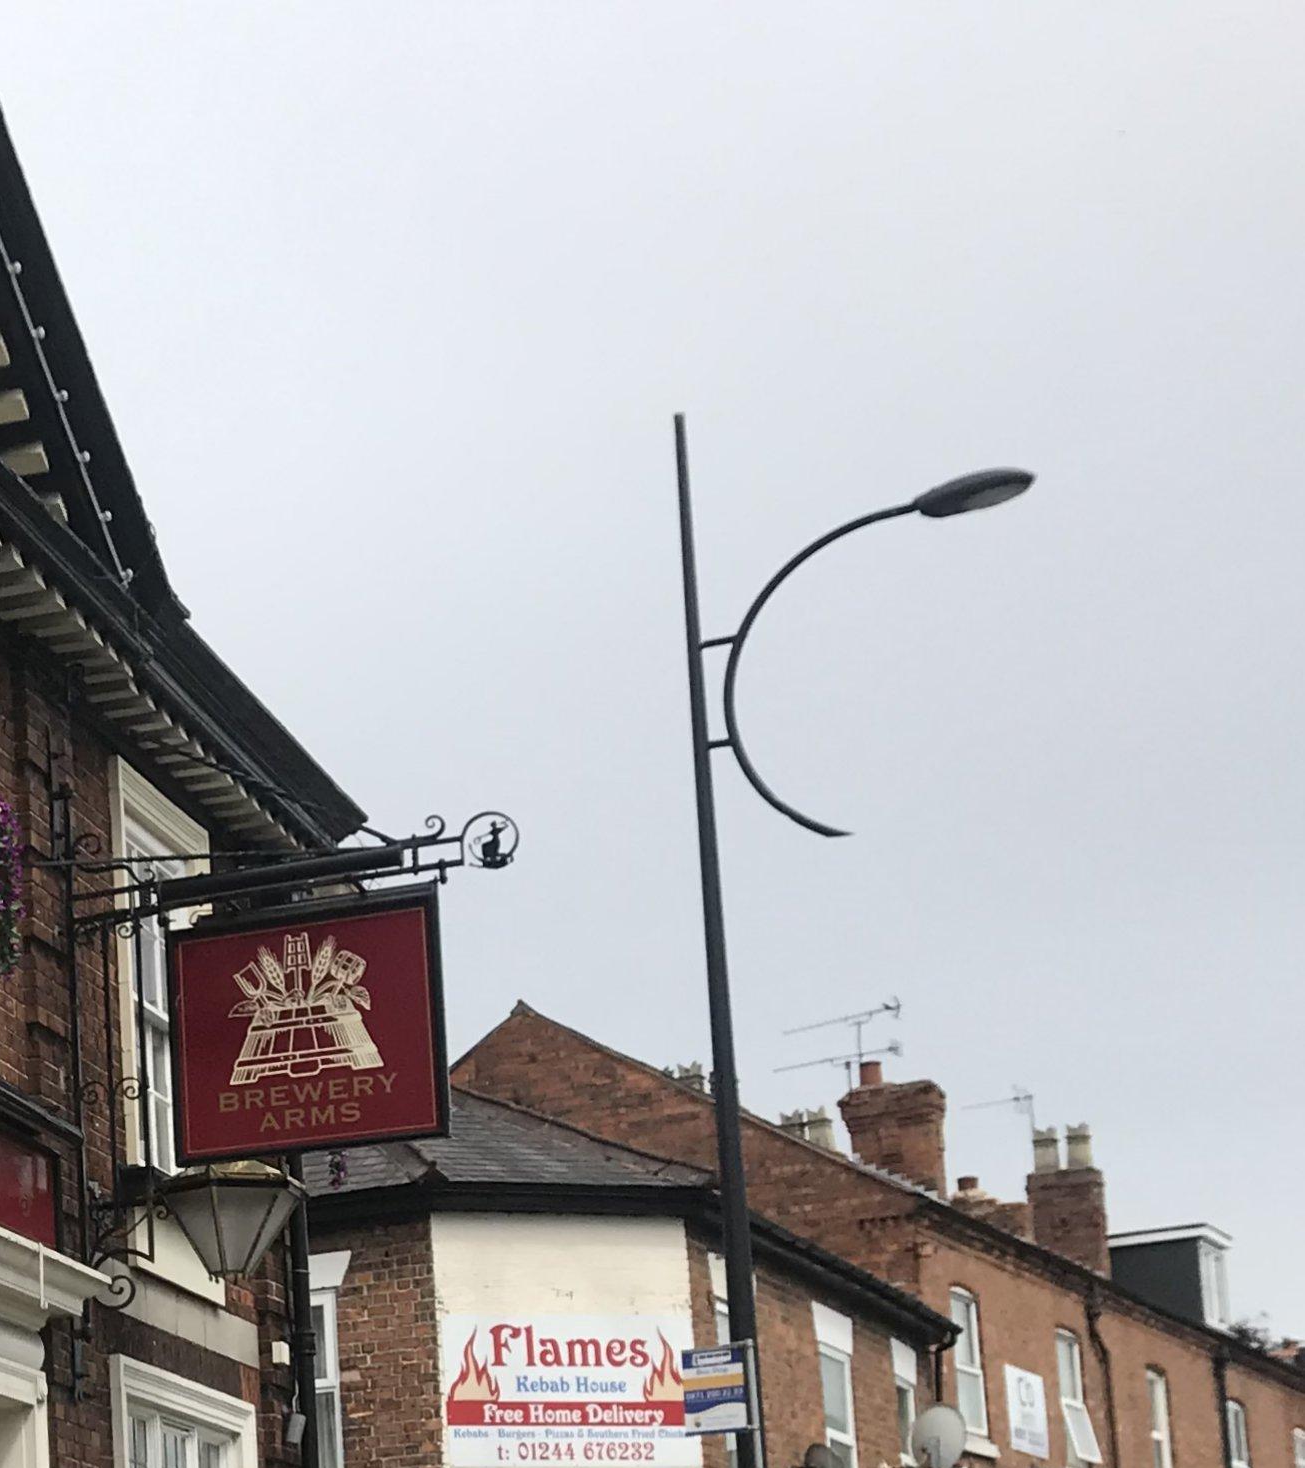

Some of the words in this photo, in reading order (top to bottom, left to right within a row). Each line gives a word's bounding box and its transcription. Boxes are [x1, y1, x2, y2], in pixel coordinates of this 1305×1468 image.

[218, 1072, 398, 1113] BREWERY
[259, 1102, 362, 1133] ARMS
[489, 1323, 651, 1368] Flames
[515, 1375, 571, 1394] Kebab
[576, 1377, 627, 1393] House
[483, 1403, 524, 1424] Free
[529, 1404, 583, 1424] Home
[586, 1404, 665, 1427] Delivery
[453, 1428, 489, 1439] Kebabs
[498, 1428, 536, 1441] Burgers
[587, 1428, 629, 1439] Southern
[631, 1428, 656, 1439] Fried
[497, 1443, 510, 1461] t:
[517, 1442, 575, 1461] 01244
[583, 1442, 655, 1461] 676232
